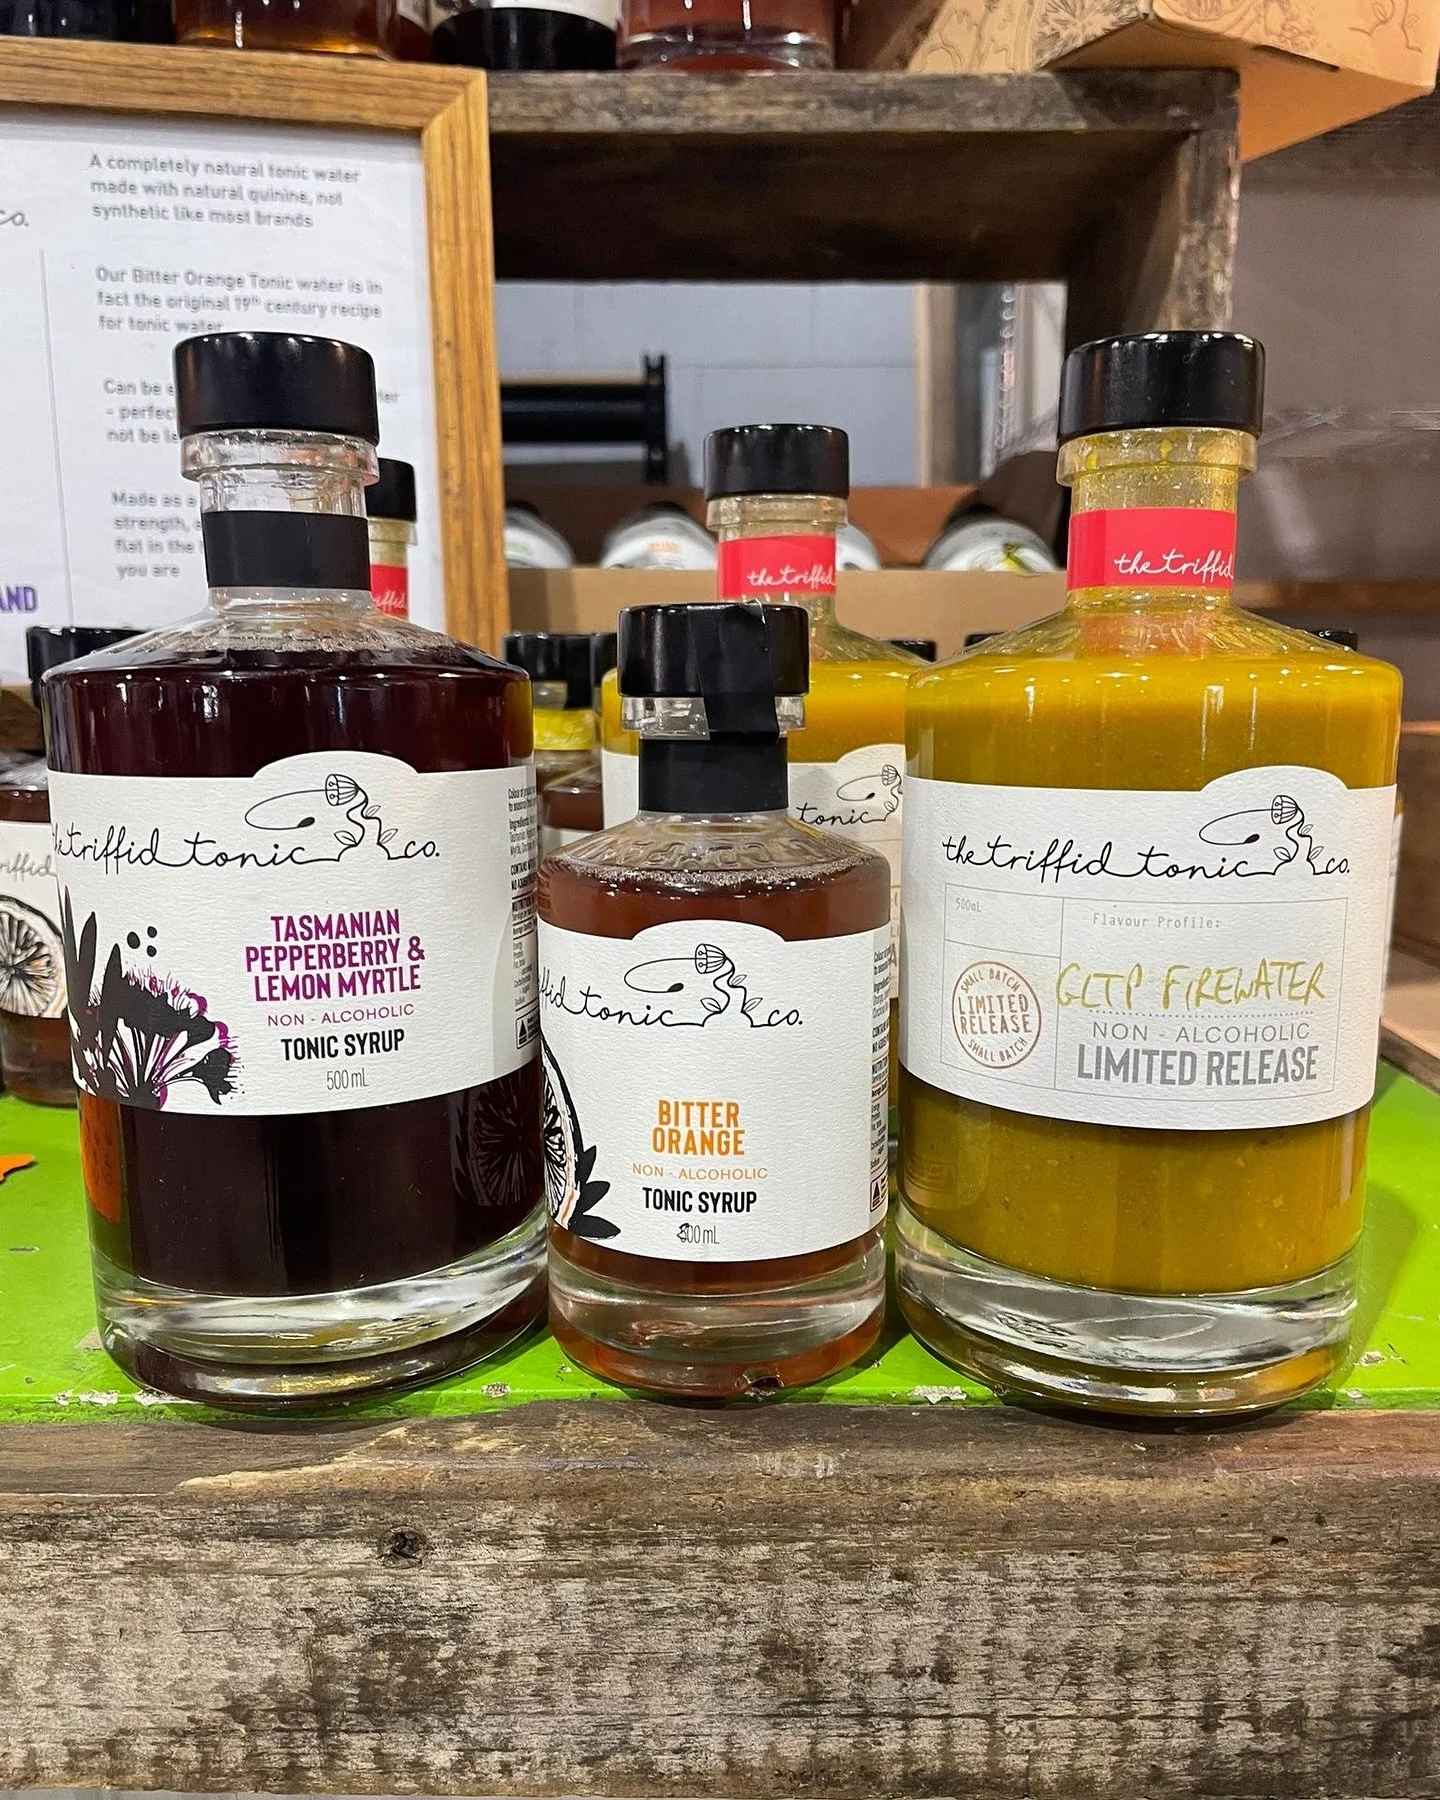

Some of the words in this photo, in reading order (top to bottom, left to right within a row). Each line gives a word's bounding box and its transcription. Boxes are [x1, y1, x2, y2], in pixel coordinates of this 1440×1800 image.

[89, 154, 101, 168] A
[107, 157, 200, 177] completely
[203, 162, 264, 178] natural
[268, 164, 308, 179] tonic
[313, 168, 360, 183] water
[91, 179, 136, 196] made
[142, 181, 178, 197] with
[183, 185, 243, 201] natural
[316, 190, 342, 206] not
[92, 204, 169, 221] synthetic
[173, 207, 203, 222] like
[209, 211, 250, 225] most
[254, 212, 313, 228] brands
[95, 267, 127, 283] Our
[132, 268, 180, 285] Bitter
[185, 271, 246, 290] Orange
[249, 274, 293, 291] Tonic
[297, 278, 343, 293] water
[348, 279, 363, 294] is
[367, 279, 382, 295] in
[97, 290, 129, 307] fact
[134, 291, 161, 308] the
[167, 294, 230, 312] original
[264, 300, 328, 318] century
[330, 302, 382, 319] recipe
[99, 315, 125, 330] for
[128, 315, 170, 332] tonic
[103, 378, 137, 395] Can
[141, 379, 161, 396] be
[120, 402, 177, 422] perfec
[107, 427, 134, 443] not
[139, 427, 161, 443] be
[112, 490, 157, 506] Made
[115, 539, 144, 554] flat
[168, 540, 195, 554] the
[117, 563, 148, 580] you
[152, 565, 180, 577] are
[796, 802, 869, 825] tonic
[184, 831, 310, 869] tonic
[404, 840, 440, 859] co.
[1137, 846, 1250, 879] tonic
[1325, 857, 1350, 875] co.
[955, 897, 982, 913] 500mL
[270, 908, 401, 942] TASMANIAN
[1092, 912, 1149, 928] Flavour
[1157, 915, 1221, 930] Profile:
[245, 938, 400, 974] PEPPERBERRY
[406, 935, 426, 962] &
[254, 969, 333, 1003] LEMON
[338, 965, 421, 995] MYRTLE
[960, 969, 985, 994] SMALL
[989, 967, 1021, 993] BATCH
[1162, 958, 1326, 1011] FIREWATER
[267, 1012, 302, 1028] NON
[321, 1003, 415, 1025] ALCOHOLIC
[579, 985, 675, 1026] tonic
[765, 1008, 804, 1027] co.
[958, 993, 1029, 1015] LIMITED
[960, 1013, 1032, 1035] RELEASE
[1092, 1020, 1148, 1042] NON
[1175, 1021, 1310, 1044] ALCOHOLIC
[281, 1035, 339, 1062] TONIC
[344, 1028, 406, 1059] SYRUP
[967, 1038, 996, 1063] SMALL
[999, 1036, 1029, 1063] BATCH
[1077, 1043, 1198, 1086] LIMITED
[1206, 1045, 1319, 1086] RELEASE
[657, 1099, 740, 1128] BITTER
[652, 1127, 746, 1156] ORANGE
[632, 1162, 664, 1178] NON
[678, 1166, 768, 1180] ALCOHOLIC
[642, 1186, 693, 1213] TONIC
[698, 1189, 758, 1214] SYRUP
